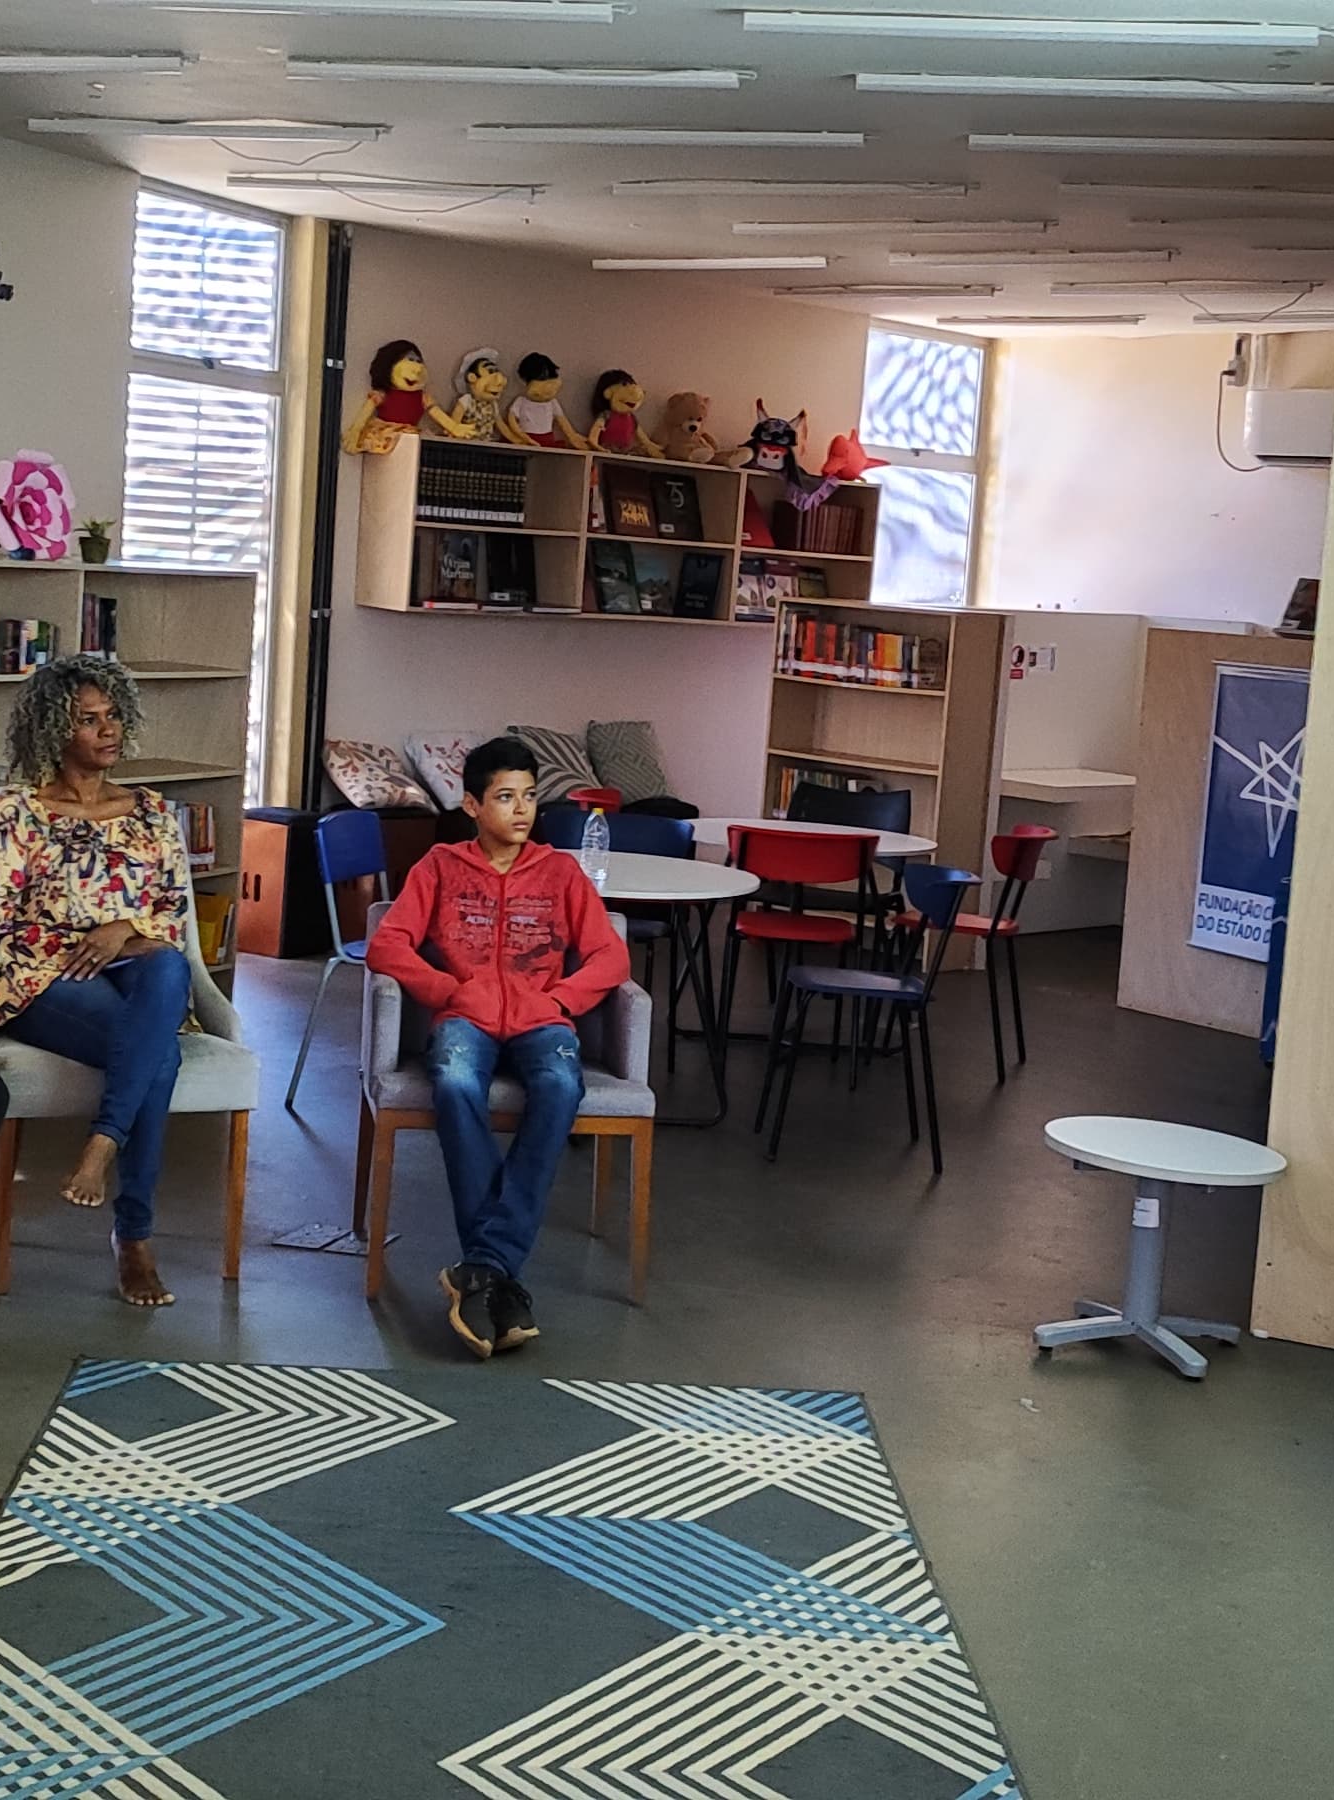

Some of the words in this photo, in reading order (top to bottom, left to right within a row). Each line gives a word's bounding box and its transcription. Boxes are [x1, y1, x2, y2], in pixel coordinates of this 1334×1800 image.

[1198, 892, 1264, 920] FUNDAÇÃO
[1196, 913, 1215, 932] DO
[1216, 918, 1262, 942] ESTADO
